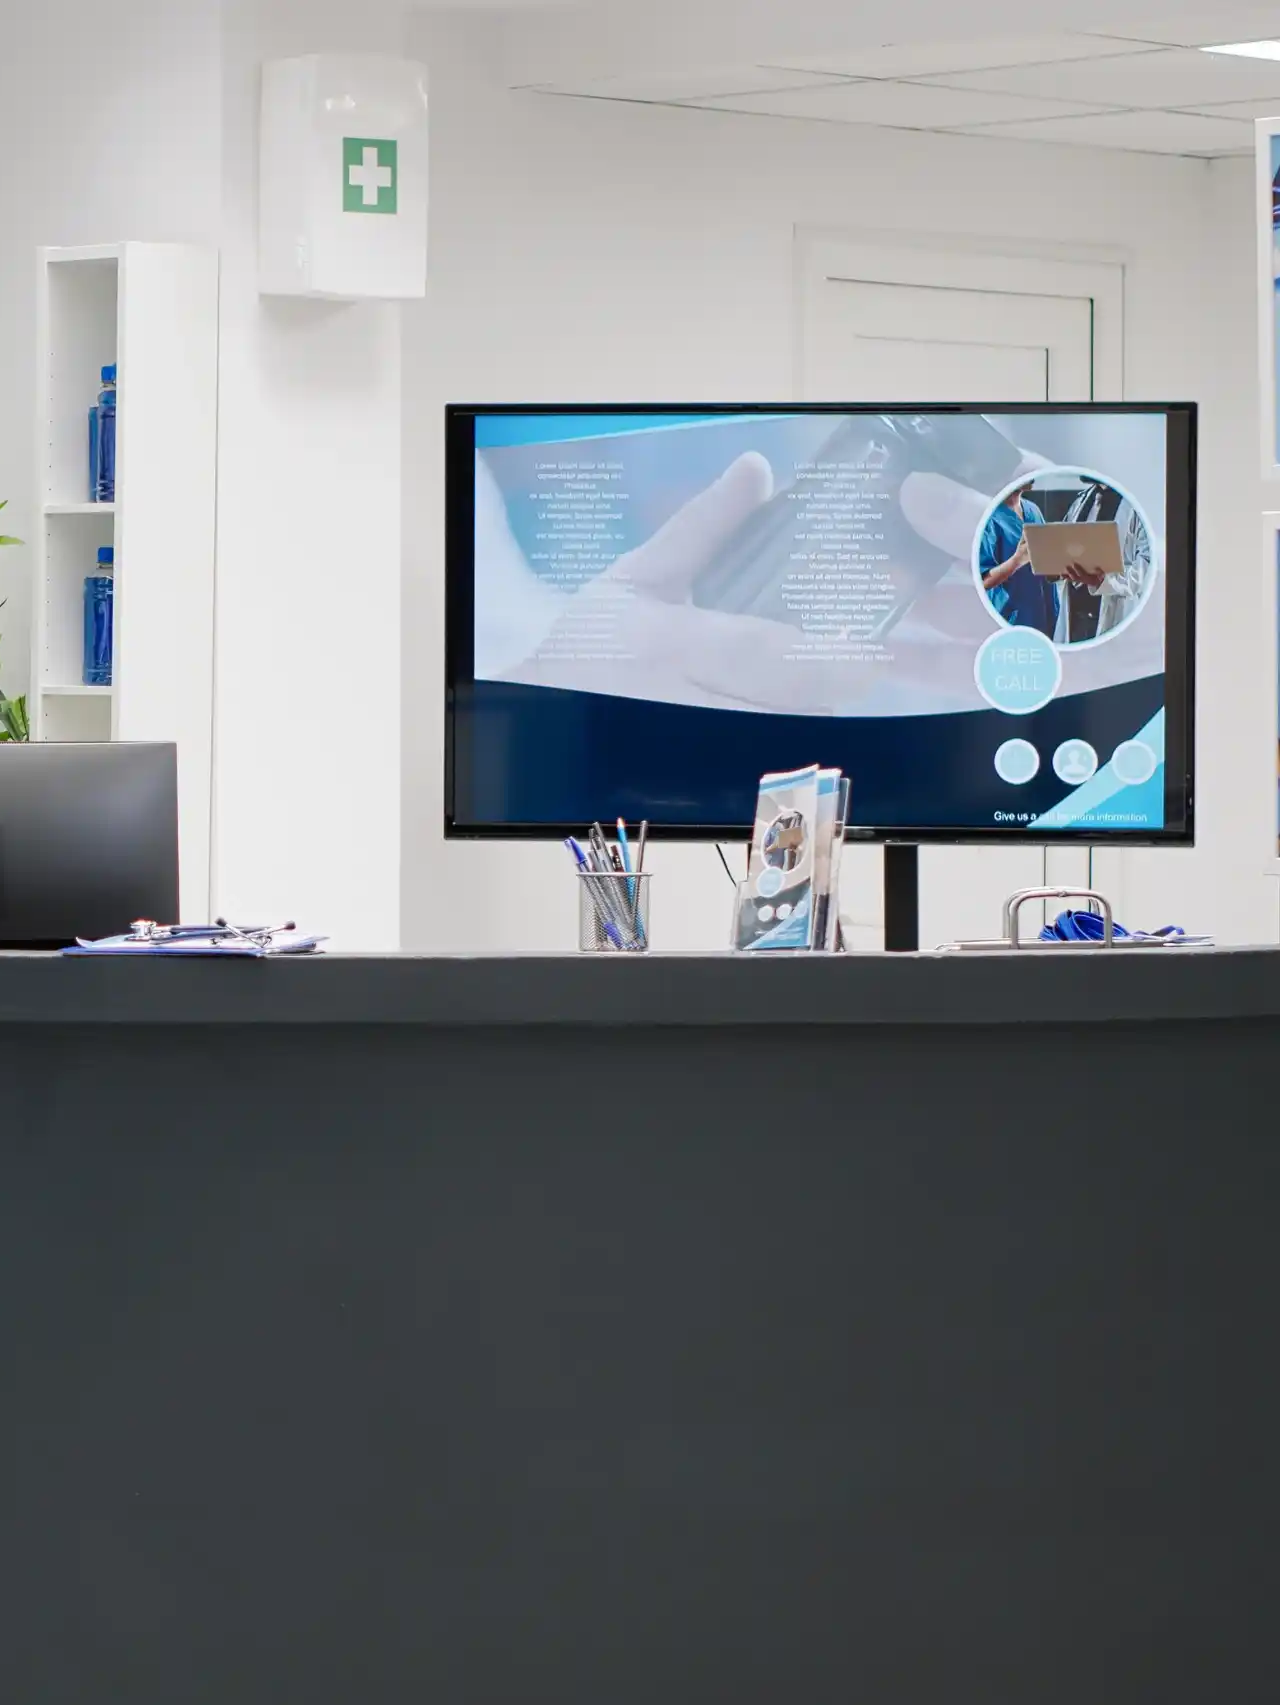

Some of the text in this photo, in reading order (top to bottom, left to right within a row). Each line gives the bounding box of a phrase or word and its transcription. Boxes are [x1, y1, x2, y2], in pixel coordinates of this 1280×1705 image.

[990, 649, 1045, 664] FREE
[995, 675, 1044, 691] CALL
[993, 811, 1015, 821] Give
[1017, 812, 1029, 821] us
[1030, 813, 1037, 821] a
